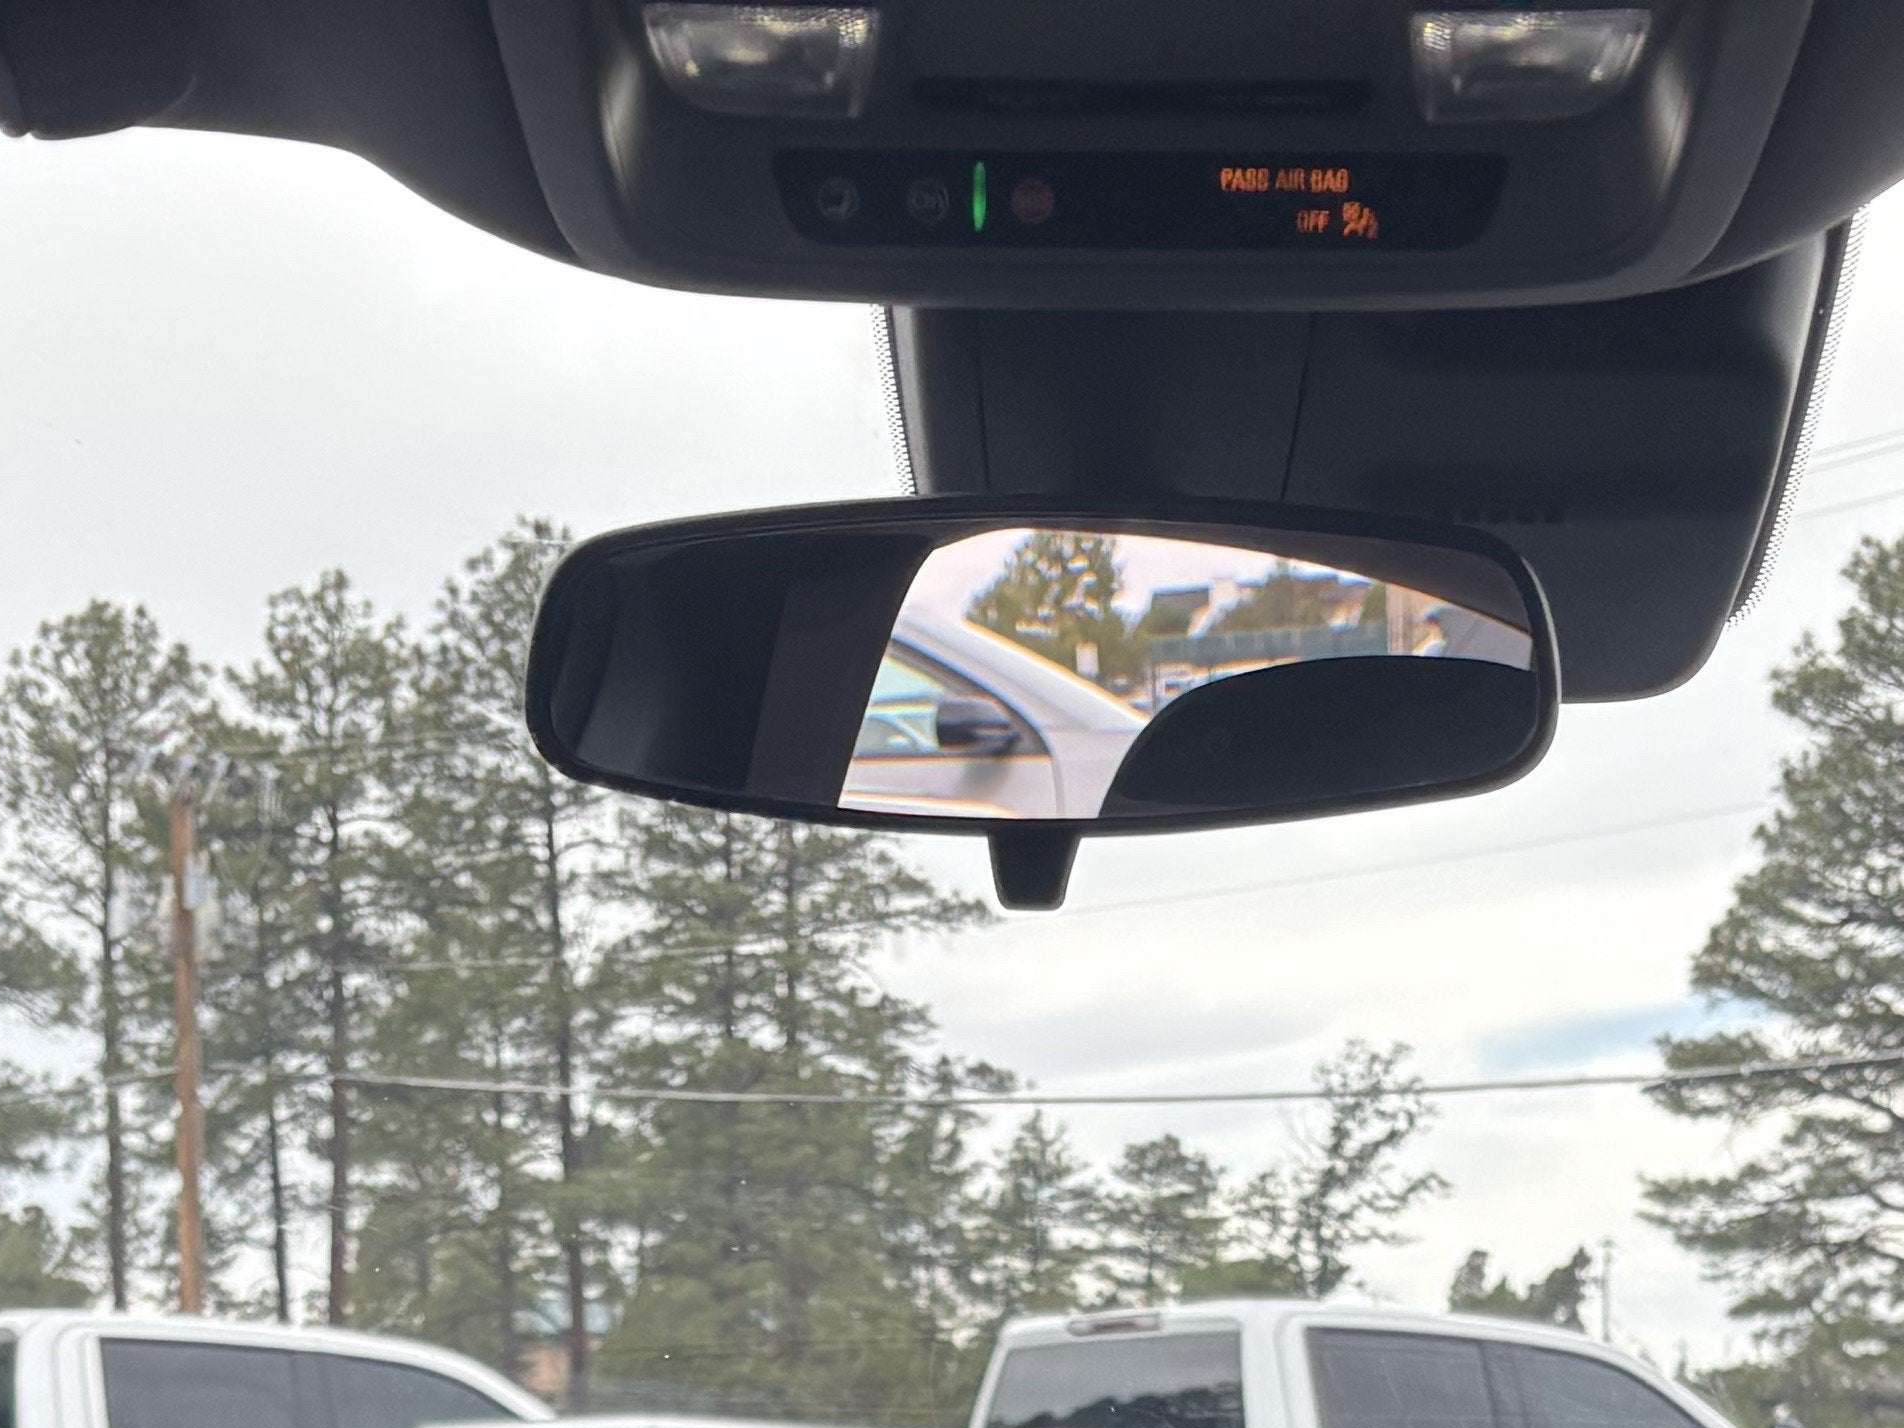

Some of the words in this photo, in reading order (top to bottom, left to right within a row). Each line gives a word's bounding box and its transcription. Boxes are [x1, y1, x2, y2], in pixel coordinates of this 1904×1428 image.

[1219, 168, 1269, 191] PASS
[1276, 168, 1305, 191] AIR
[1310, 170, 1349, 192] BAG
[1296, 209, 1329, 234] OFF
